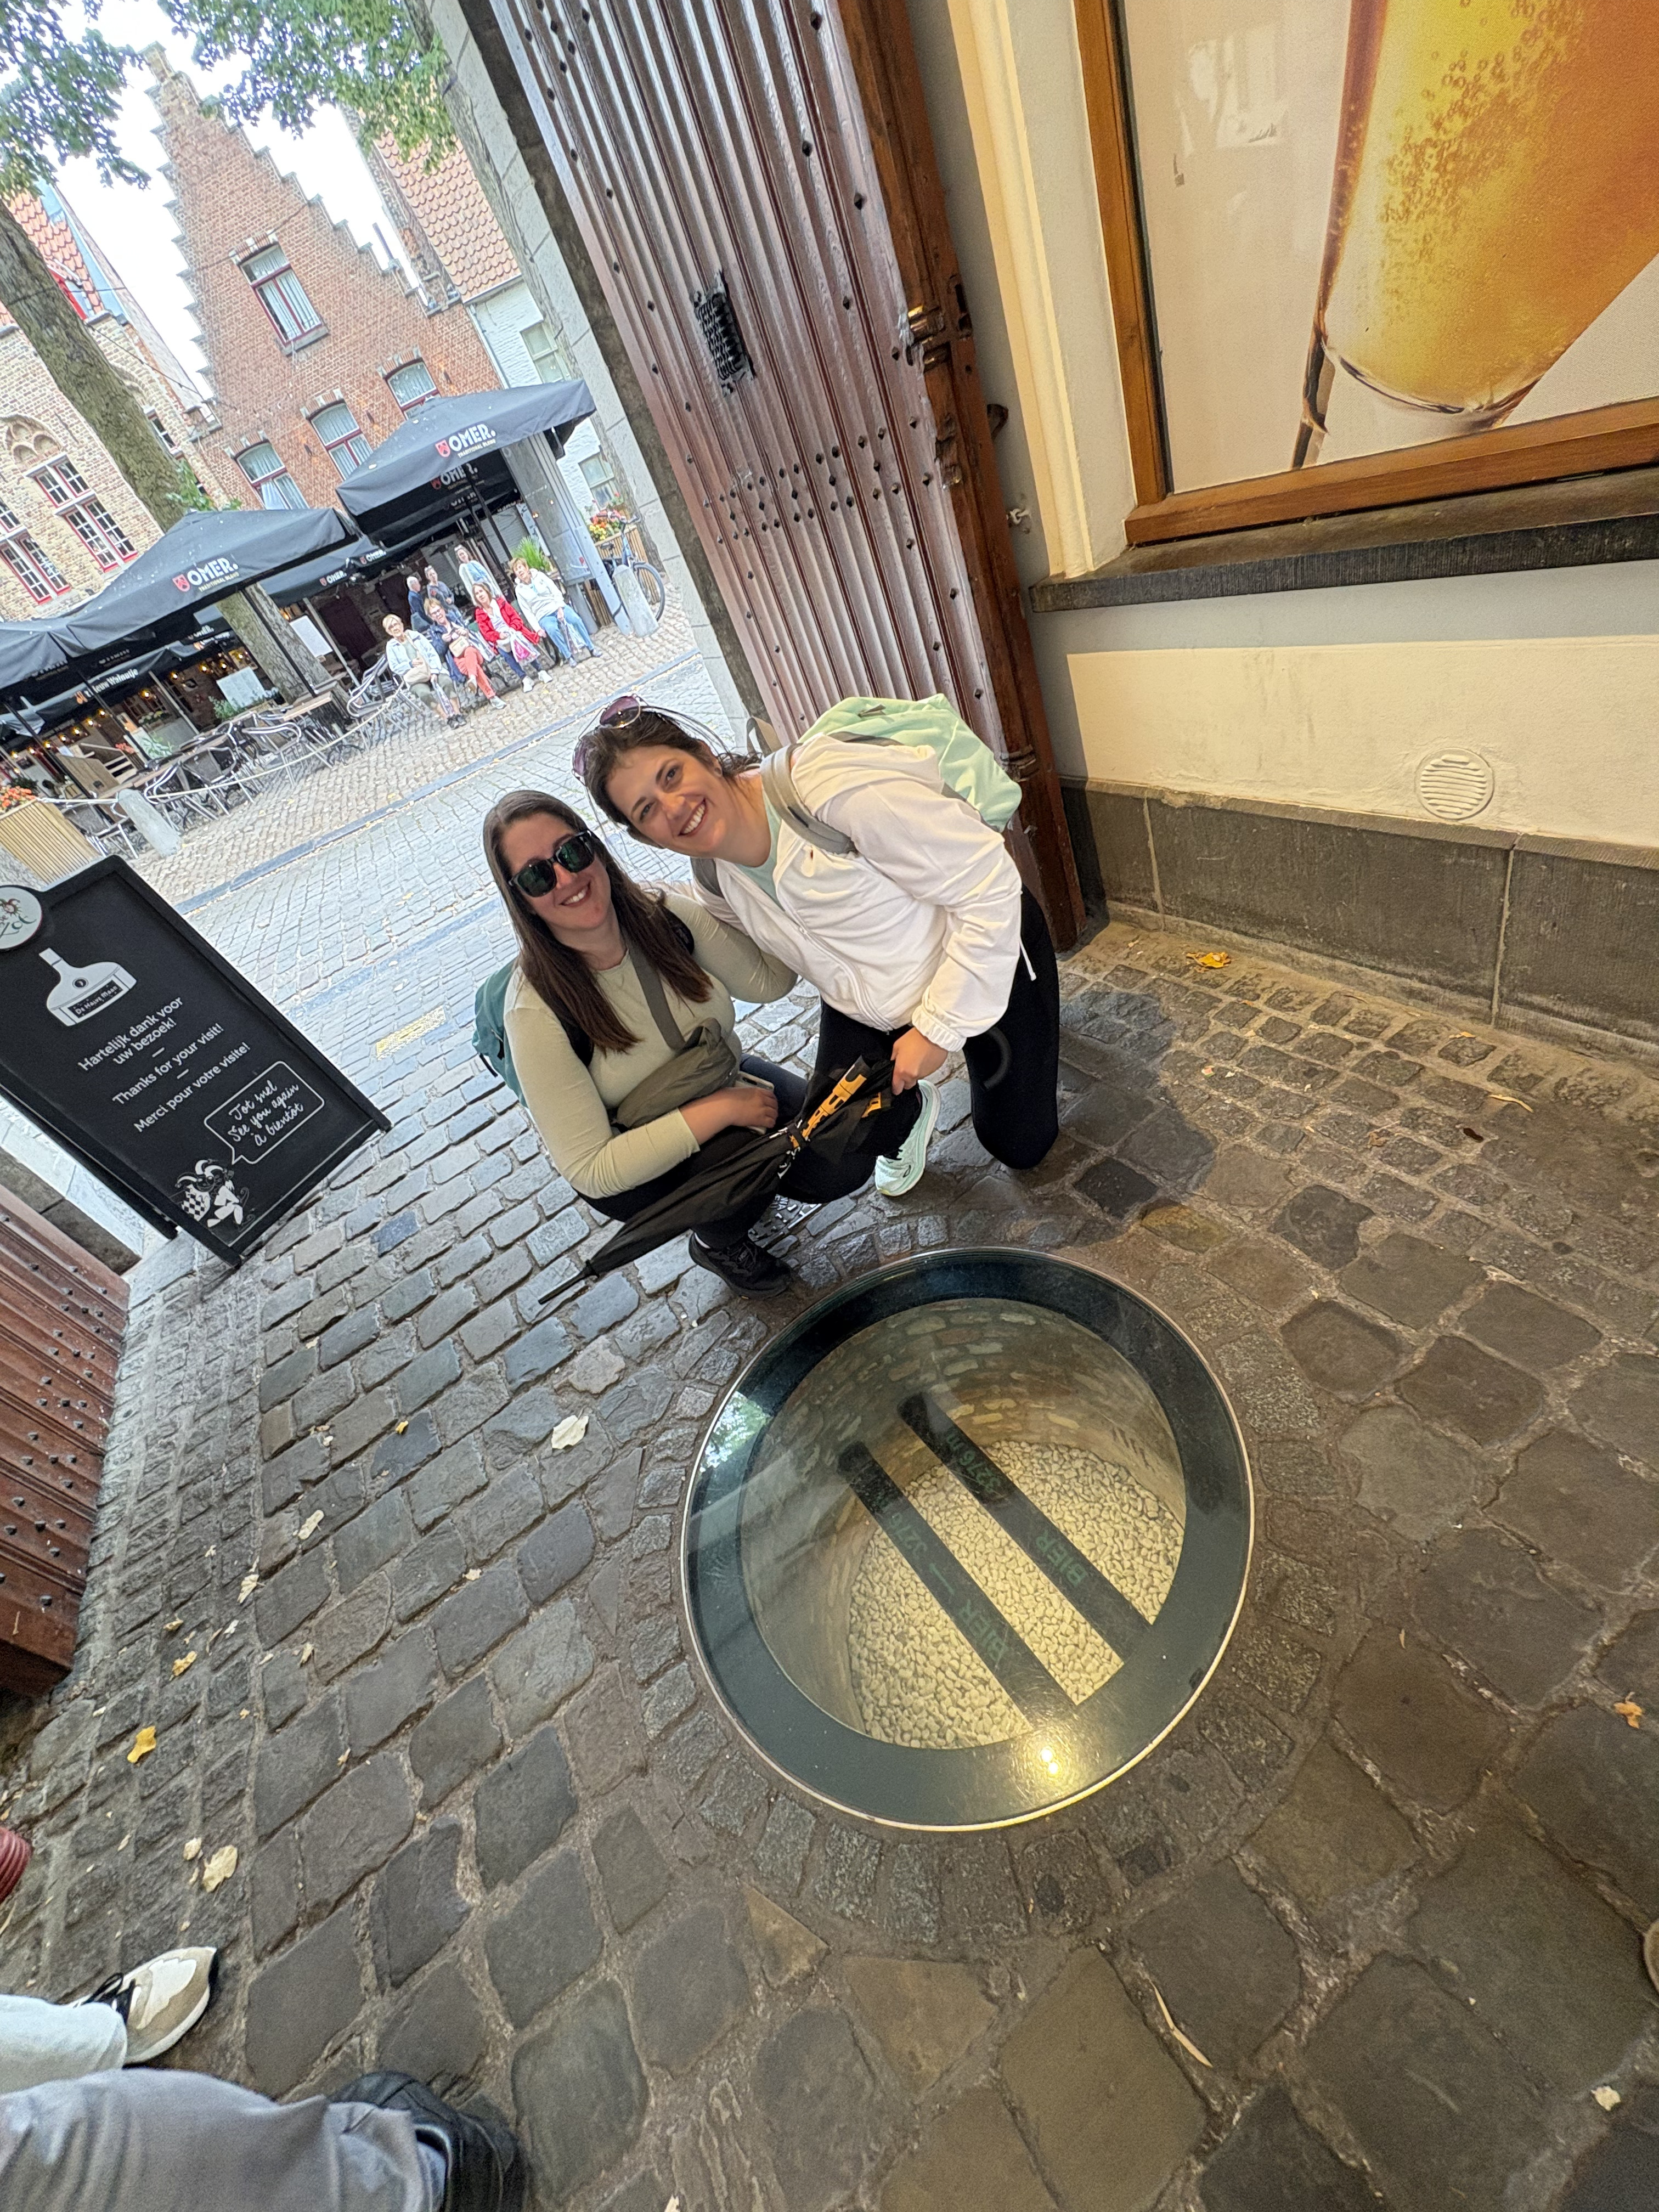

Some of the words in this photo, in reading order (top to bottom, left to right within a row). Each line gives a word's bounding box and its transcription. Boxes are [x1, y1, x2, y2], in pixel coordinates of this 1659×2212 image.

[449, 424, 496, 452] OMER.
[187, 557, 239, 585] OMER.
[326, 570, 347, 584] OMER.
[366, 549, 386, 562] OMER.
[78, 1033, 131, 1071] Hartelijk
[129, 1014, 159, 1037] dank
[156, 997, 183, 1017] voor
[113, 1047, 133, 1064] uw
[131, 1017, 177, 1051] bezoek!
[112, 1073, 156, 1104] Thanks
[155, 1060, 173, 1076] for
[172, 1042, 198, 1066] your
[197, 1023, 224, 1045] visit!
[134, 1104, 168, 1132] Merci
[166, 1086, 193, 1110] pour
[193, 1065, 221, 1088] votre
[219, 1042, 251, 1068] visite!
[229, 1100, 255, 1120] Tot
[255, 1080, 277, 1103] snel
[228, 1124, 250, 1142] See
[250, 1108, 271, 1128] you
[272, 1085, 299, 1108] again
[266, 1103, 303, 1136] bientôt
[960, 1450, 1001, 1493] 3276
[1036, 1529, 1088, 1587] BIER
[960, 1599, 1006, 1661] BIER
